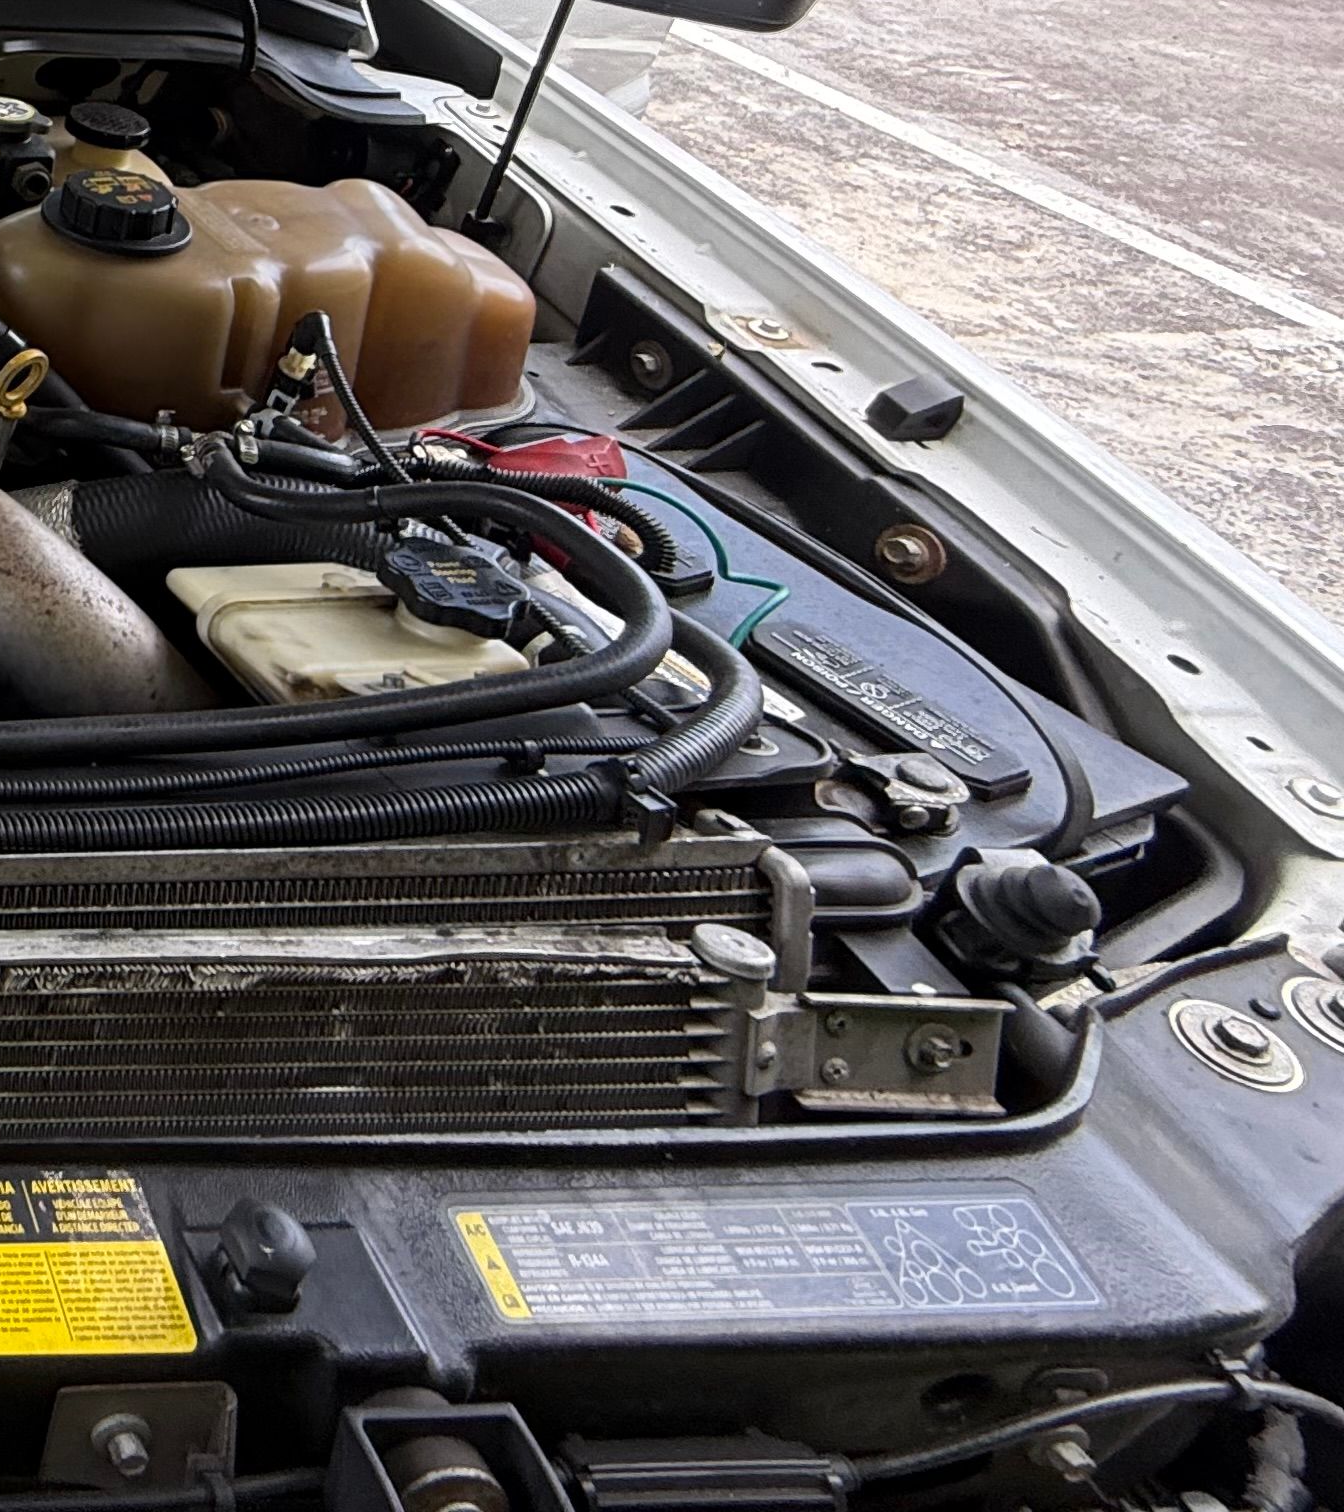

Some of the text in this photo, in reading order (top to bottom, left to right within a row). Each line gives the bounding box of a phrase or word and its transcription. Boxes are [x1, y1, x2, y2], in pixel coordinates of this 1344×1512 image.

[31, 1178, 137, 1194] AVERTISSEMENT
[465, 1223, 486, 1237] A/C
[550, 1220, 576, 1235] SAE
